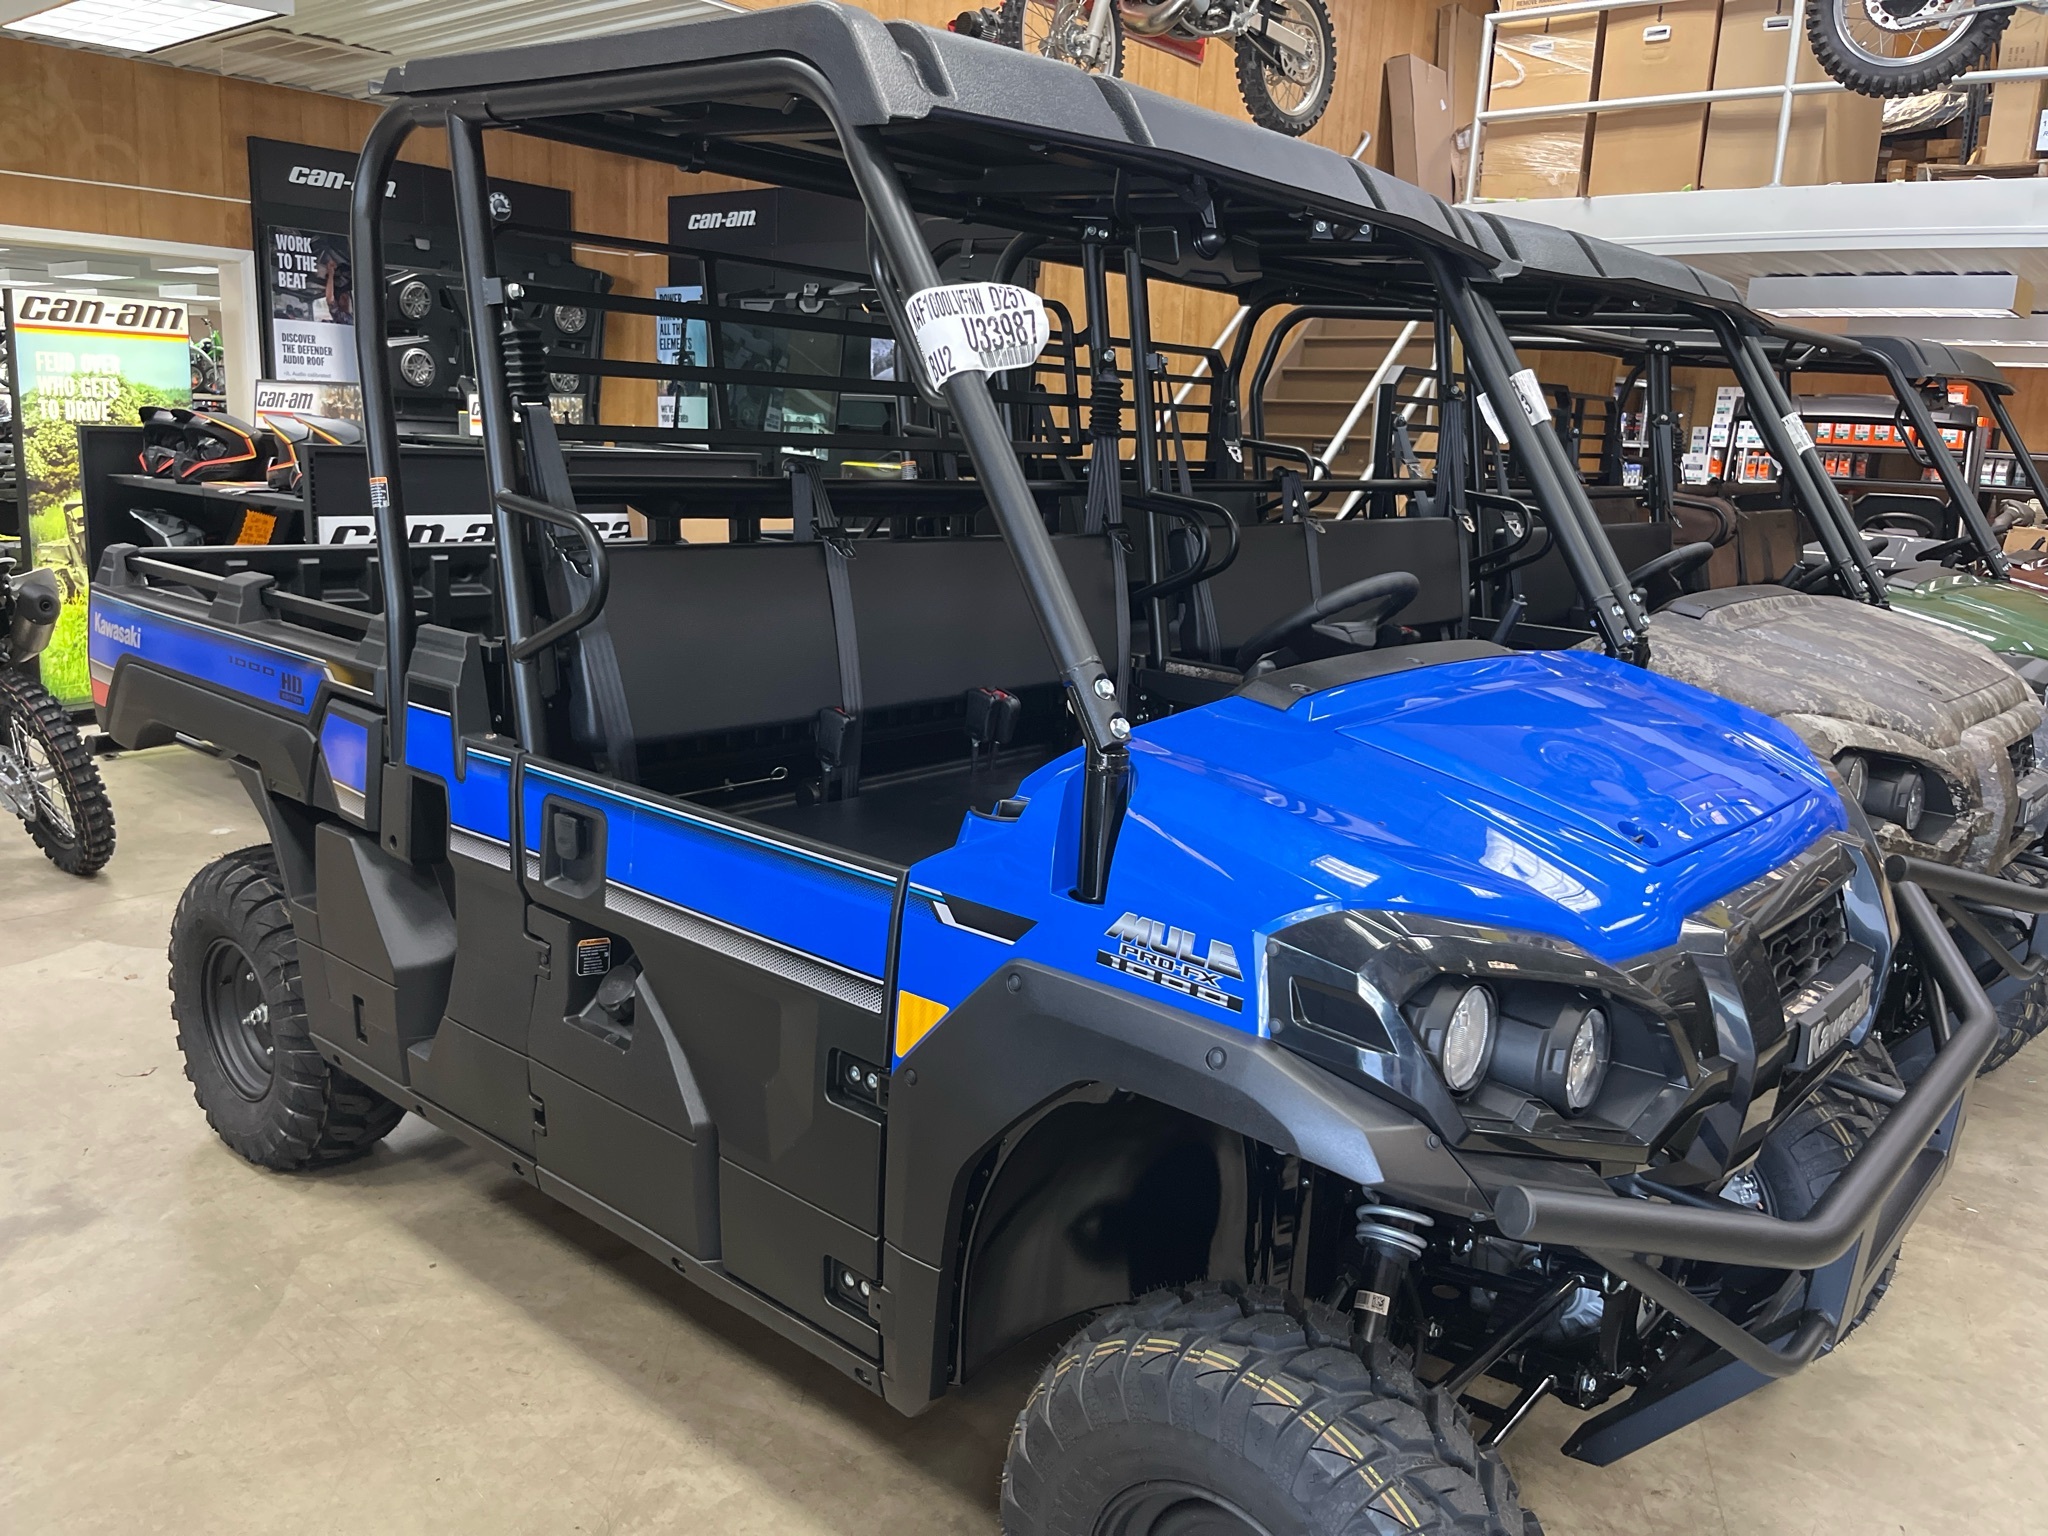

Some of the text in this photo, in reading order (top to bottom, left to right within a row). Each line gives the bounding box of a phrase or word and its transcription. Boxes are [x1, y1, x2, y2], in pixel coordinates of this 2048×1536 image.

[688, 209, 756, 230] can-am
[275, 233, 312, 254] WORK
[277, 252, 318, 273] TO THE
[278, 270, 308, 290] BEAT
[19, 295, 184, 331] can-am
[281, 332, 316, 345] DISCOVER
[660, 323, 671, 336] ALL
[961, 309, 1038, 354] U33987
[282, 344, 333, 357] THE DEFENDER
[283, 354, 325, 367] AUDIO ROOF
[928, 345, 956, 382] BU2
[36, 375, 120, 399] WHO GETS
[38, 398, 113, 422] TO DRIVE
[257, 390, 314, 410] can-am
[94, 612, 142, 649] Kawasaki
[229, 655, 275, 677] 1000
[281, 672, 303, 695] HD
[1104, 911, 1245, 982] MULE
[1110, 955, 1229, 1007] 1000
[1807, 977, 1871, 1065] Kawasaki
